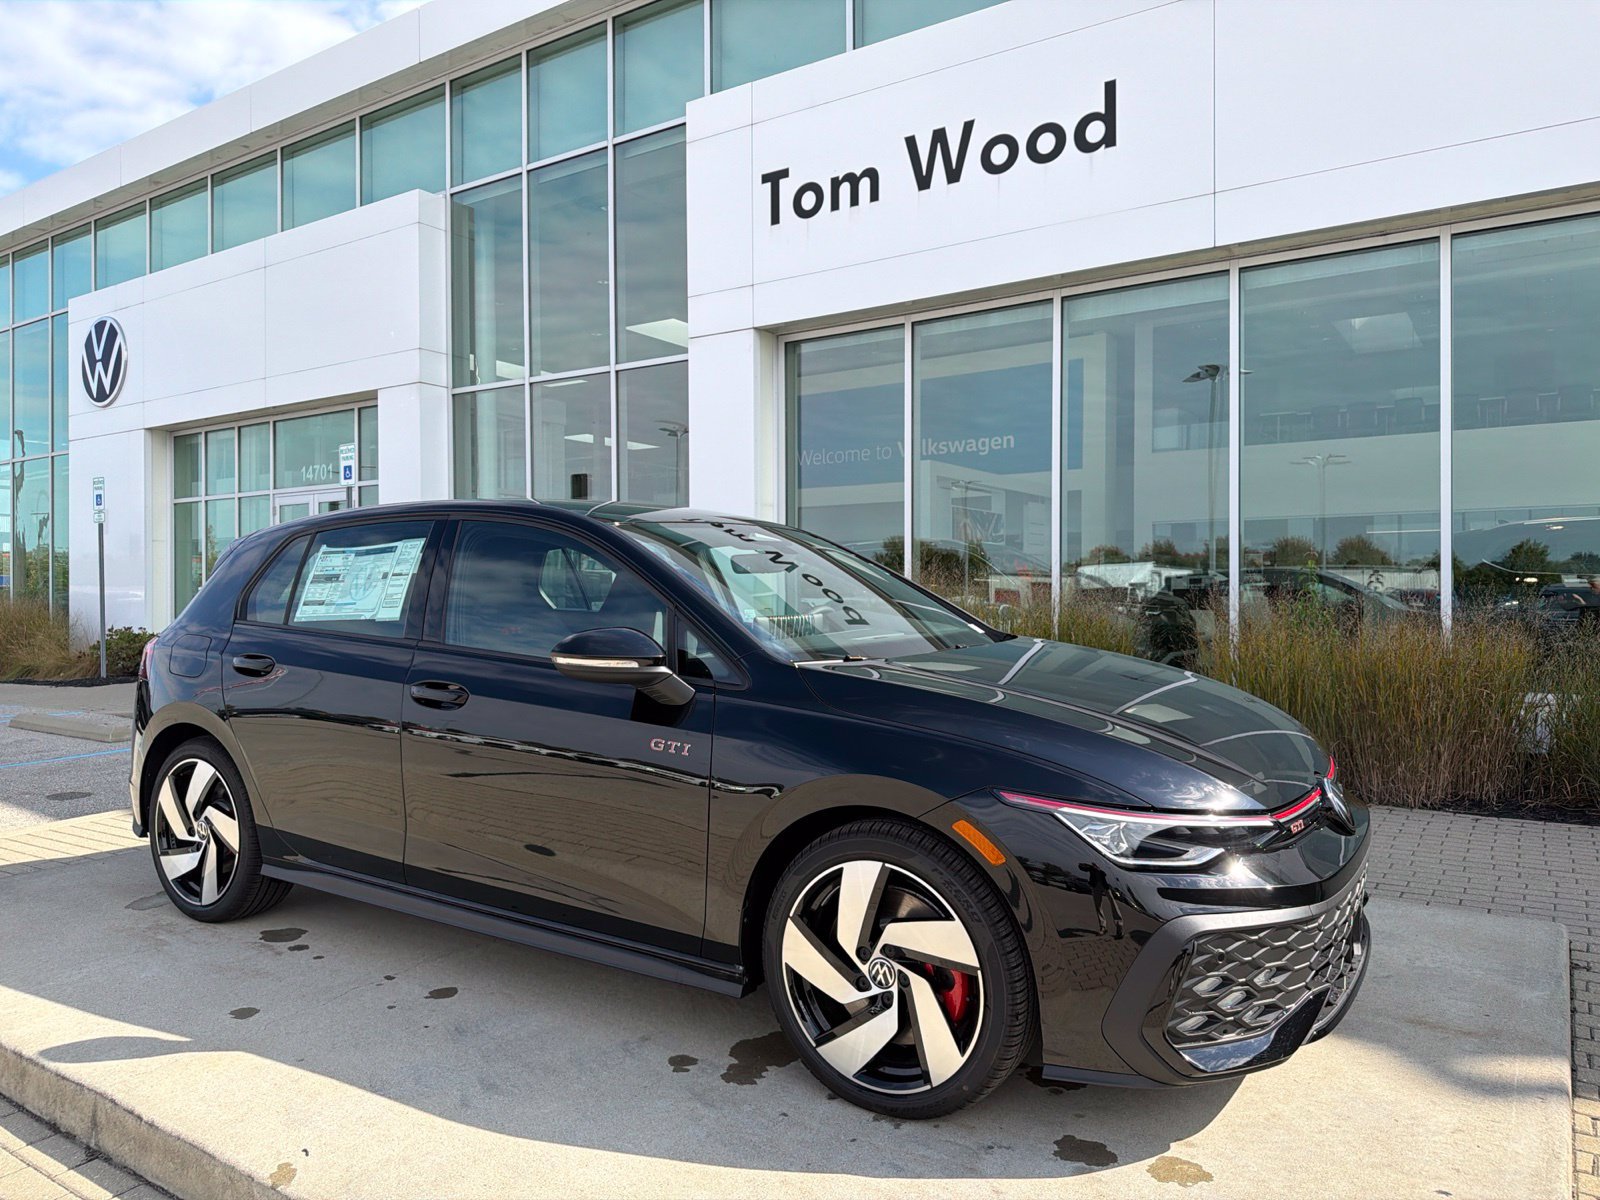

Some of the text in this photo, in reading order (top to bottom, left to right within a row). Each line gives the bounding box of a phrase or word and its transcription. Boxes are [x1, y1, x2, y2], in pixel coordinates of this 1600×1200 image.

[761, 79, 1117, 226] Tom Wood
[82, 316, 128, 407] VW
[797, 435, 1014, 466] Welcome to Vlkswagen
[301, 463, 333, 481] 14701
[650, 738, 691, 756] GTI
